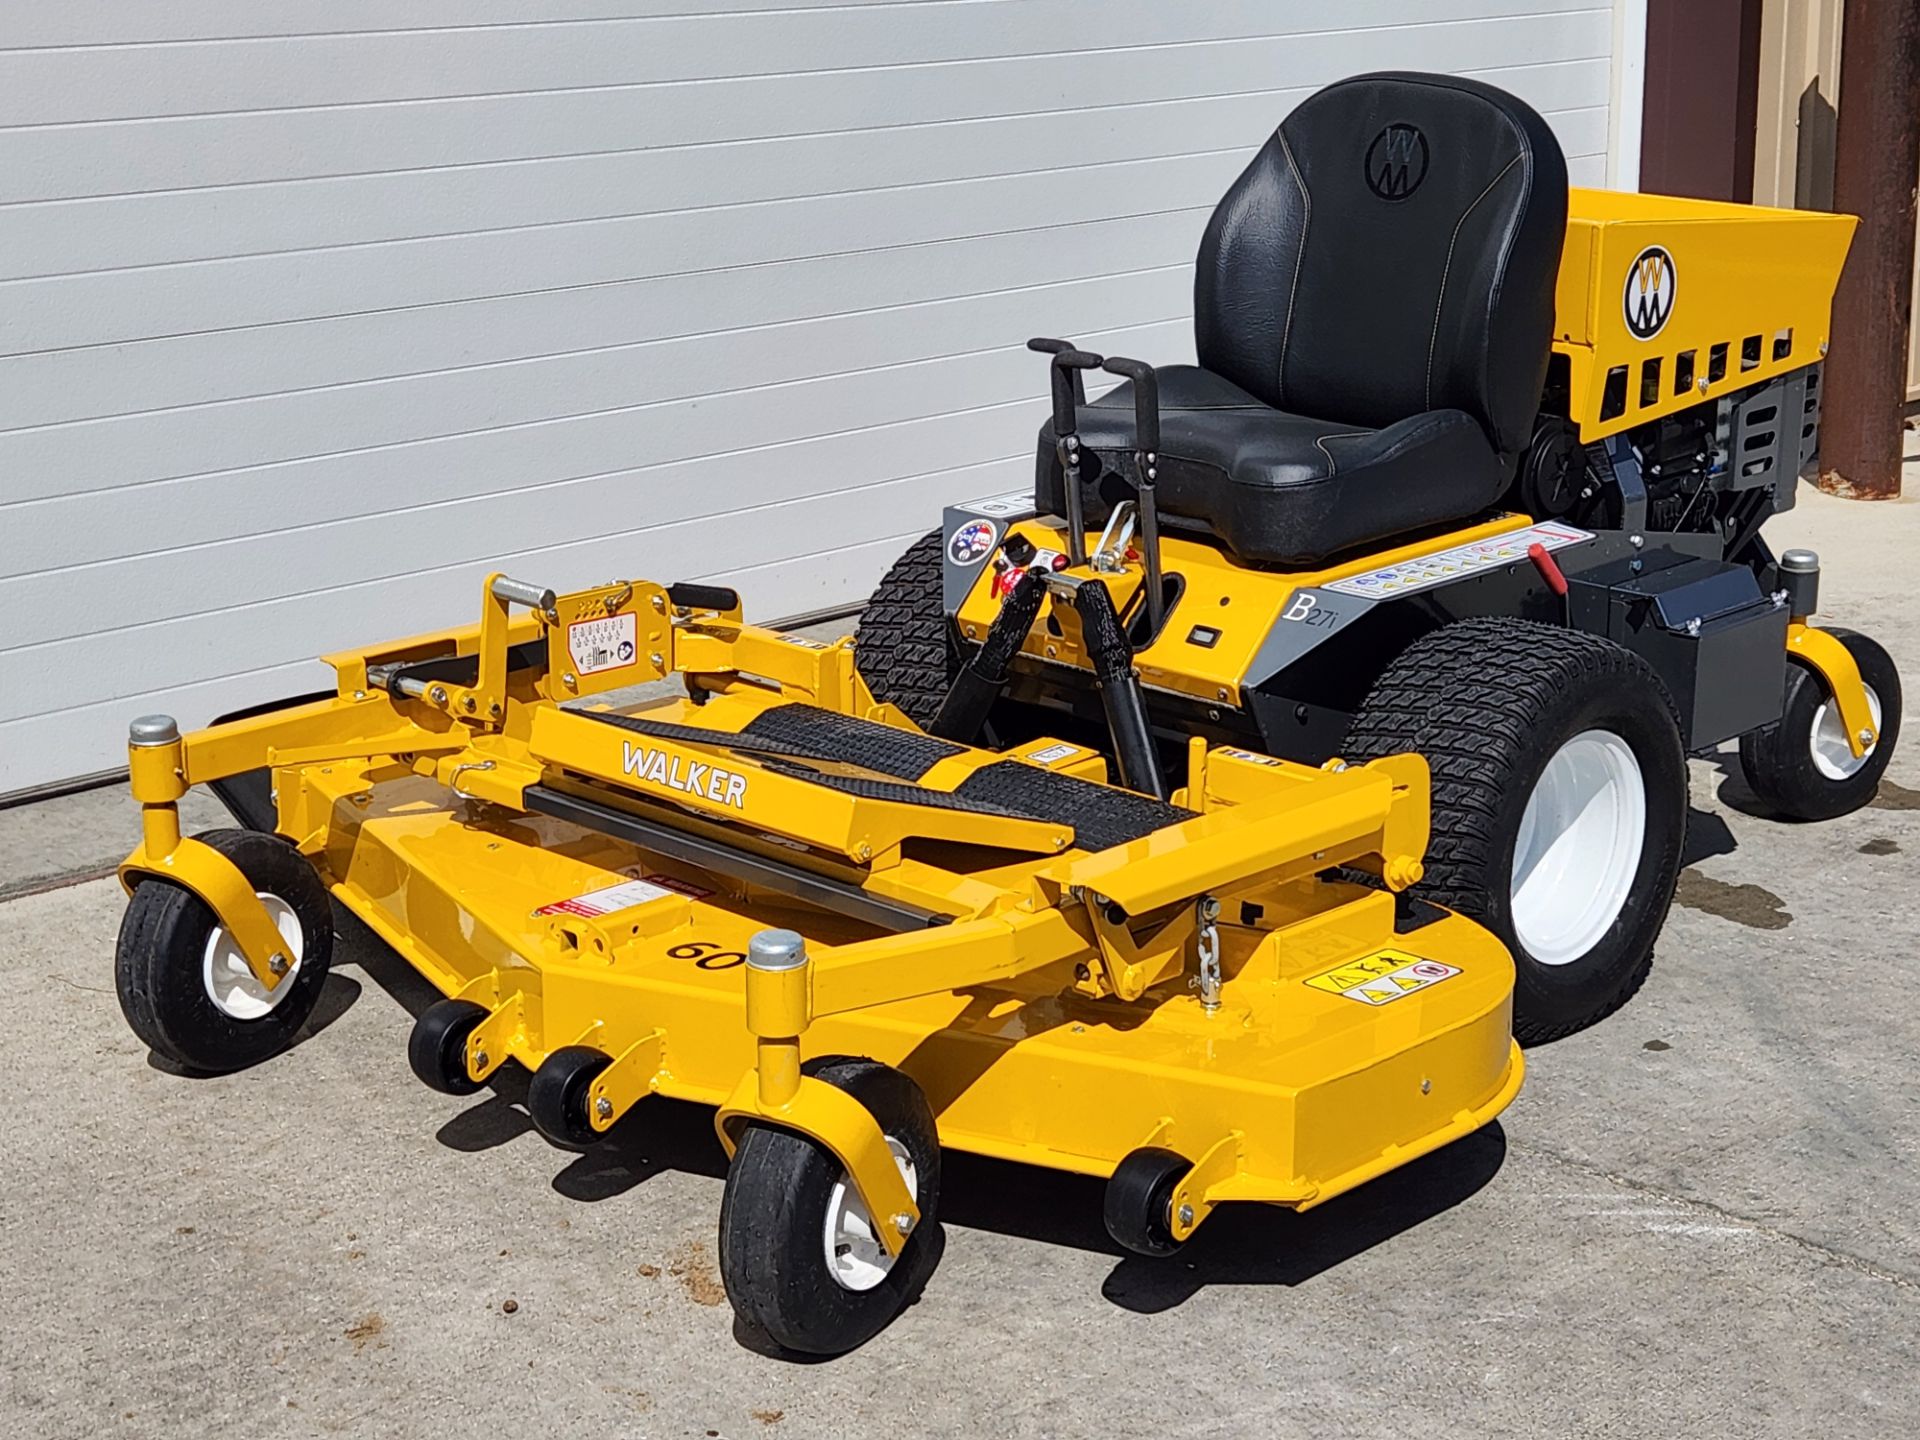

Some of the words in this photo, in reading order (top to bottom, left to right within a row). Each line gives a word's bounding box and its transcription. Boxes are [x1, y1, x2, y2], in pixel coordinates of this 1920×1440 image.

[1281, 592, 1340, 629] B27i
[622, 740, 747, 809] WALKER
[666, 942, 748, 970] 60
